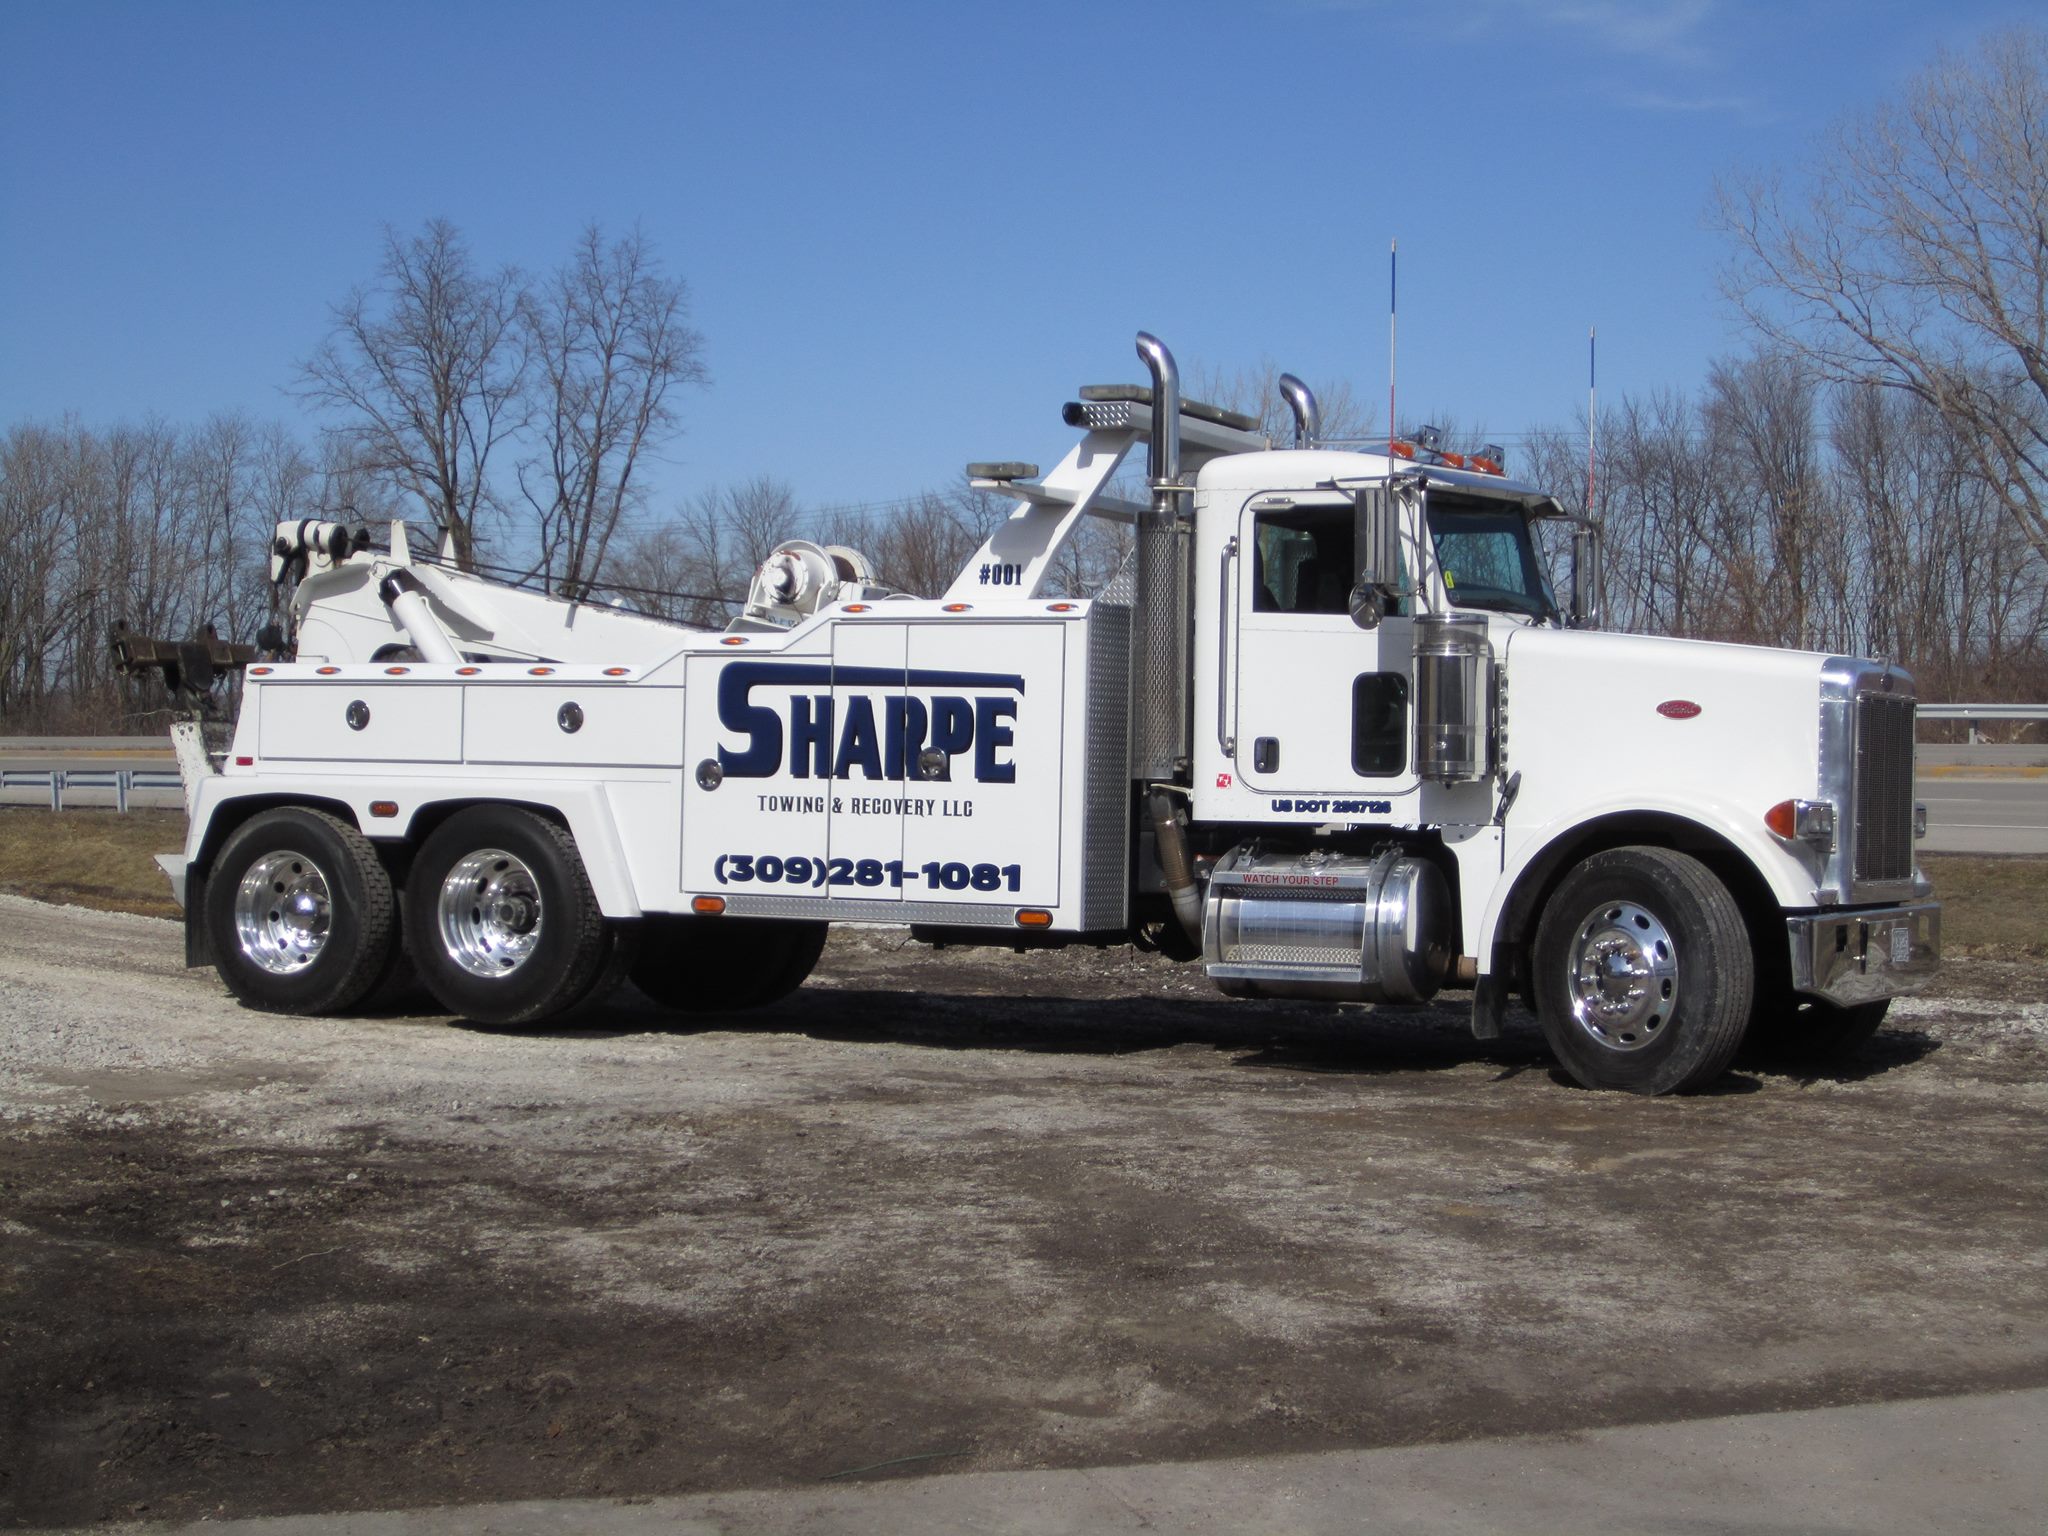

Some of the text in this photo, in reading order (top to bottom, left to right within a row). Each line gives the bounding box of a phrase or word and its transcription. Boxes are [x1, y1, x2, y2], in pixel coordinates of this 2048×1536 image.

[979, 563, 1022, 586] #001
[717, 661, 1025, 784] SHARPE
[757, 795, 973, 817] TOWING & RECOVERY LLC
[1294, 799, 1330, 813] DOT
[714, 854, 1021, 892] (309)281-1081
[1243, 874, 1339, 886] WATCH YOUR STEP
